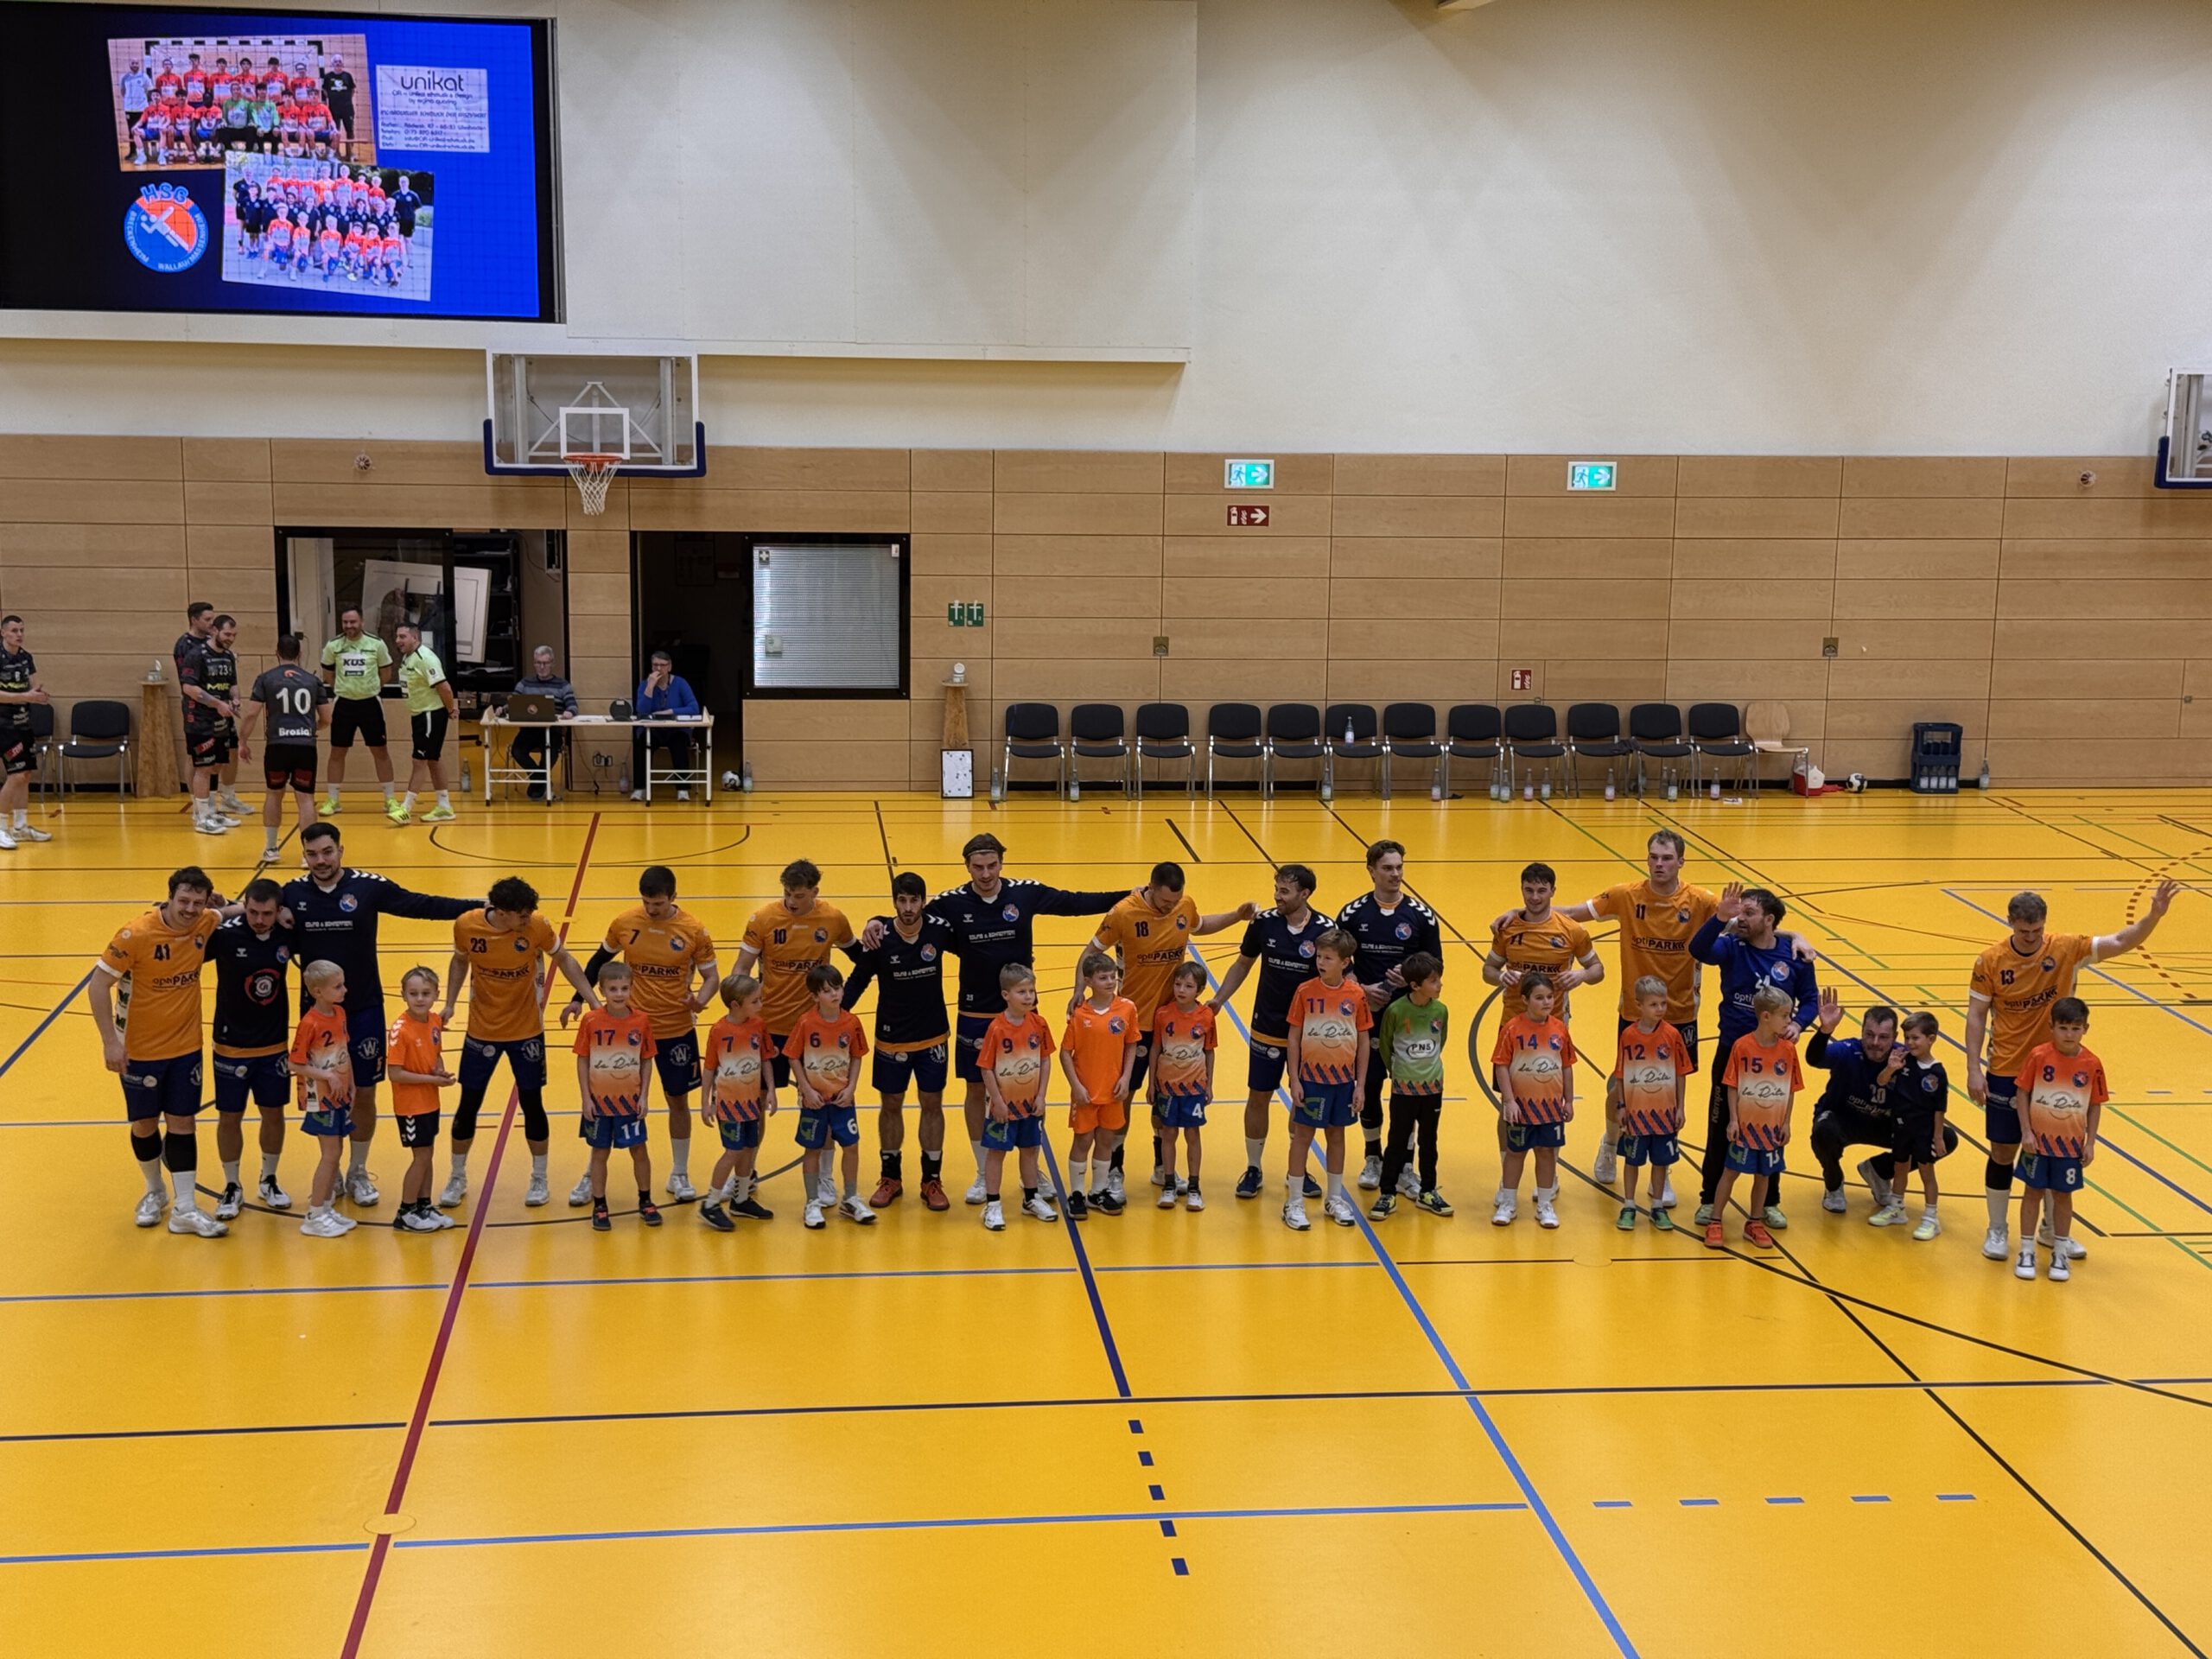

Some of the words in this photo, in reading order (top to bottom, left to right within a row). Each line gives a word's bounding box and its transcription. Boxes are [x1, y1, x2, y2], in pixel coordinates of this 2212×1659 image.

[401, 70, 464, 92] unikat
[140, 181, 189, 204] HSG
[276, 688, 311, 715] 10
[1635, 904, 1646, 920] 11
[628, 929, 640, 945] 7
[773, 928, 787, 944] 10
[1135, 920, 1149, 938] 18
[154, 943, 170, 961] 41
[470, 937, 487, 953] 23
[1999, 969, 2015, 986] 13
[1306, 997, 1325, 1014] 11
[1166, 1021, 1175, 1037] 4
[1402, 1018, 1411, 1034] 1
[321, 1030, 334, 1047] 2
[594, 1029, 616, 1046] 17
[721, 1036, 734, 1052] 7
[810, 1033, 821, 1048] 6
[1002, 1038, 1014, 1054] 9
[1516, 1033, 1537, 1051] 14
[1411, 1043, 1432, 1052] PNS
[1624, 1044, 1645, 1061] 12
[1740, 1057, 1763, 1074] 15
[2043, 1065, 2055, 1083] 8
[1192, 1103, 1203, 1119] 4
[1711, 1085, 1721, 1123] Kempa
[621, 1120, 641, 1140] 17
[847, 1118, 858, 1135] 6
[2066, 1167, 2076, 1185] 8
